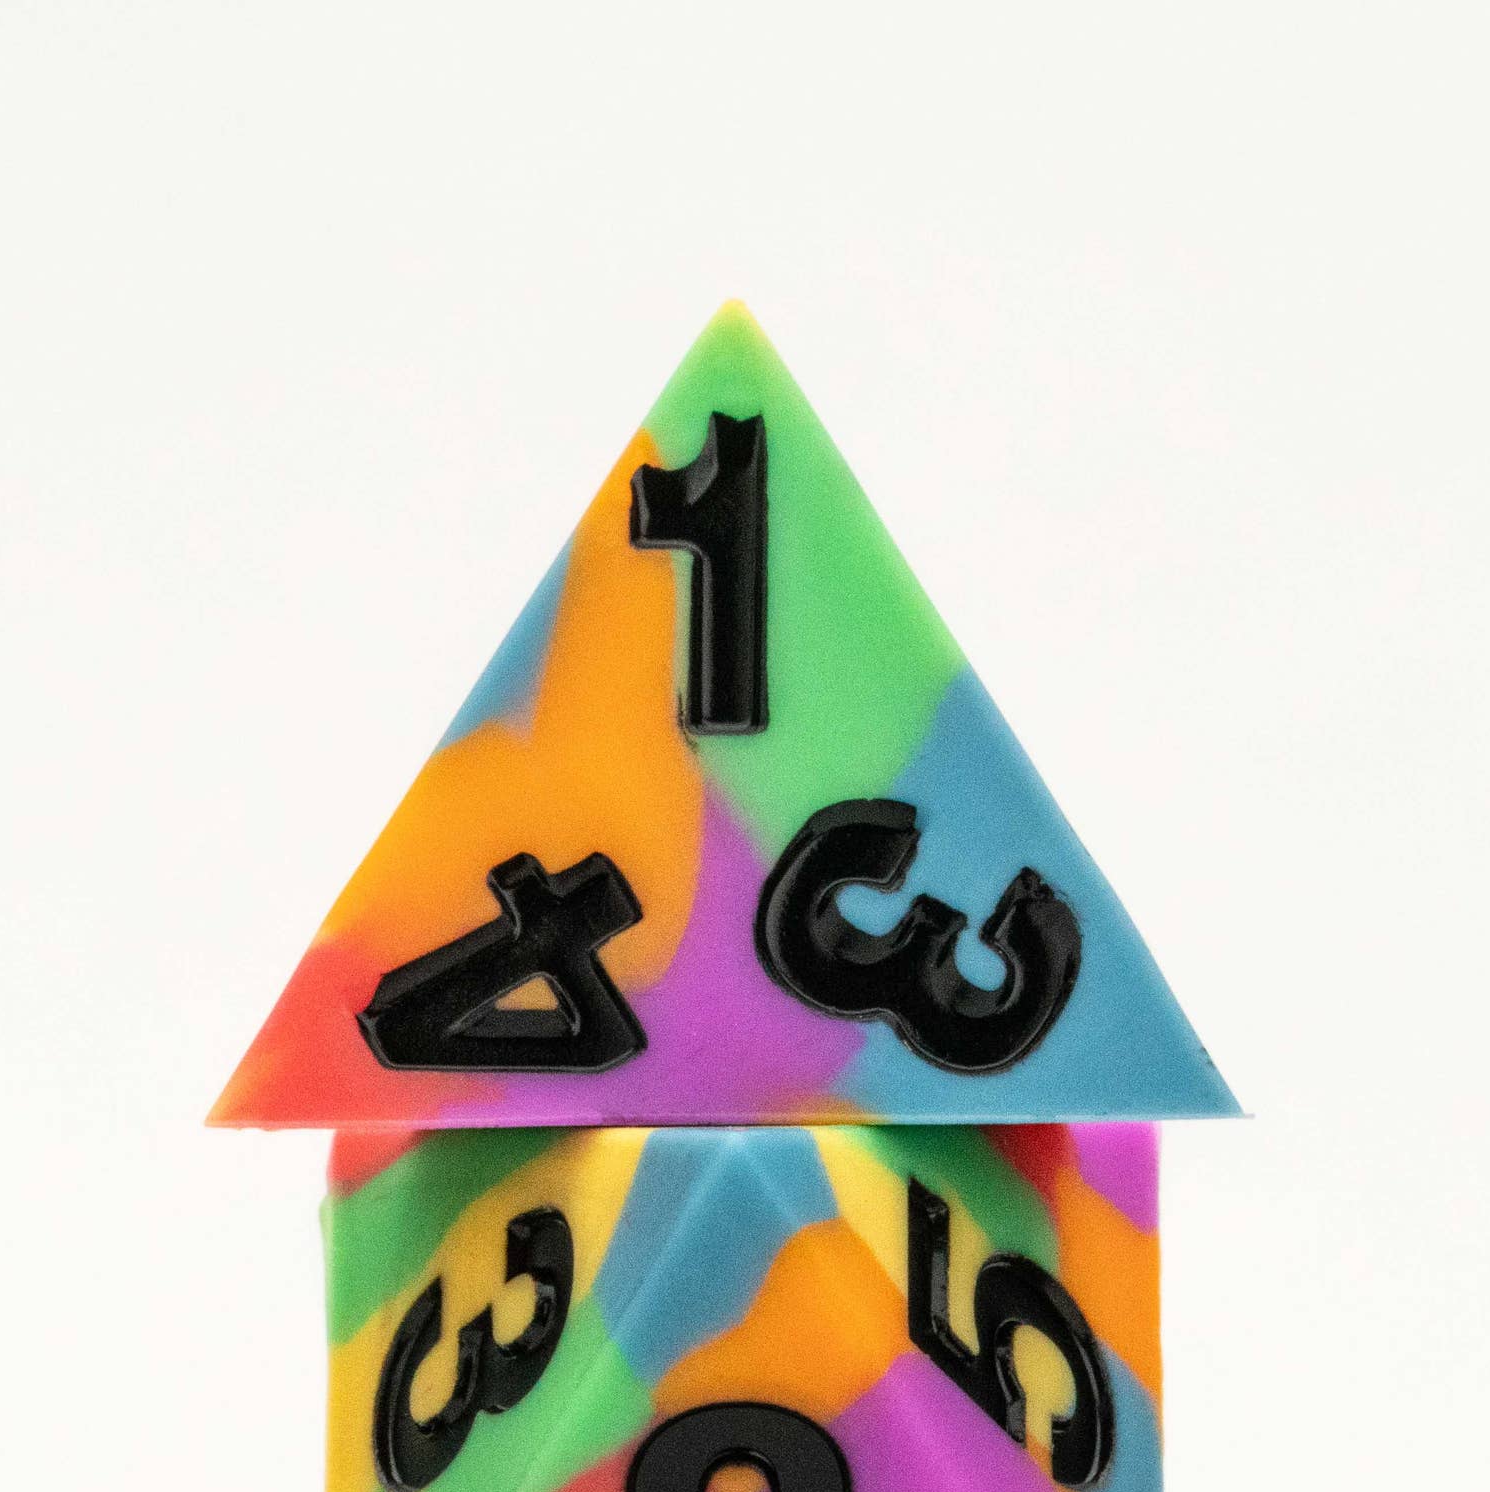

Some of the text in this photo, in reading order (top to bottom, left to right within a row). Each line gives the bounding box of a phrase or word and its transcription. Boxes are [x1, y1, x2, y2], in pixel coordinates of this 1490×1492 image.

[628, 410, 770, 736] 1
[356, 851, 649, 1076] 4
[752, 798, 1083, 1077] 3
[907, 1173, 1117, 1492] 5
